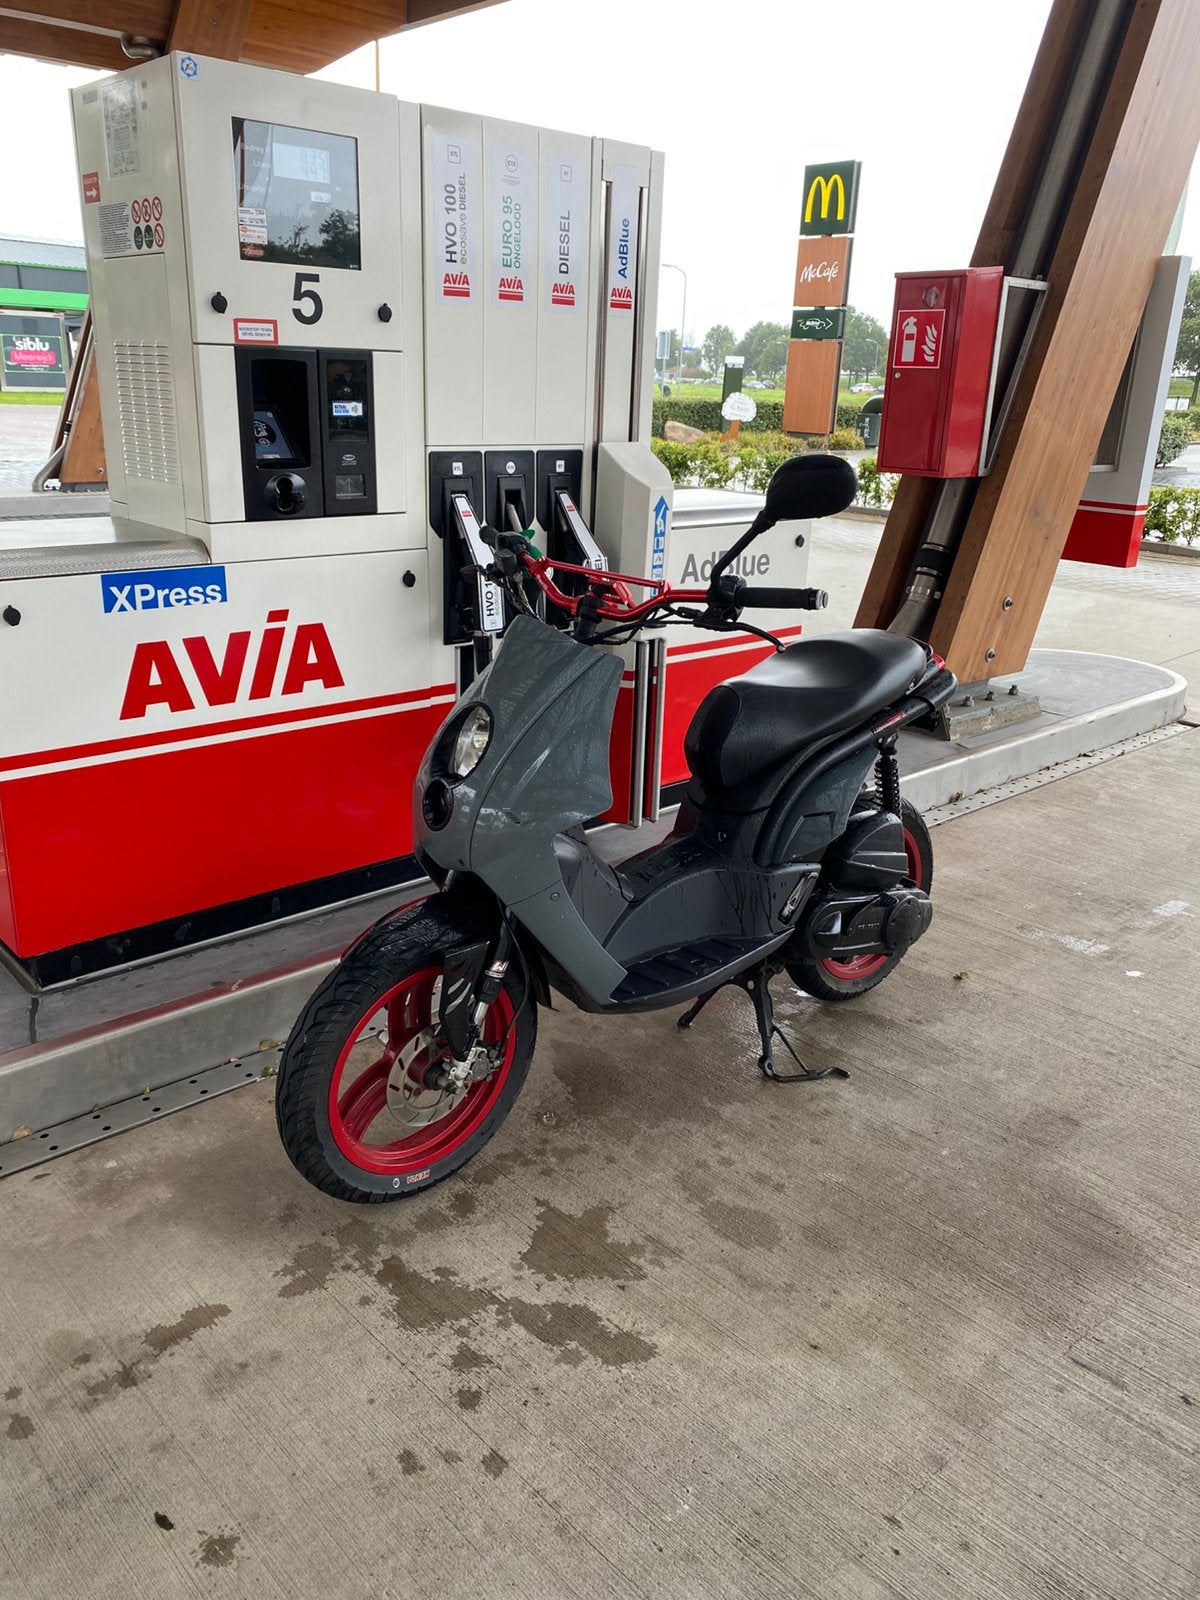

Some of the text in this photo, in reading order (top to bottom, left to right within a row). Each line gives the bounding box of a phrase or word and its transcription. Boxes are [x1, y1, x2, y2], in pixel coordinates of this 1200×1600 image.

[444, 183, 457, 263] HVO 100
[458, 172, 467, 265] ecosave DIESEL
[502, 194, 513, 215] 95
[502, 220, 513, 268] EURO
[513, 203, 522, 269] ONGELOOD
[558, 210, 571, 275] DIESEL
[617, 218, 630, 279] AdBlue
[800, 261, 839, 283] McCafé
[292, 272, 323, 326] 5
[15, 336, 50, 351] siblu
[109, 583, 223, 613] XPress
[485, 591, 495, 617] HVO
